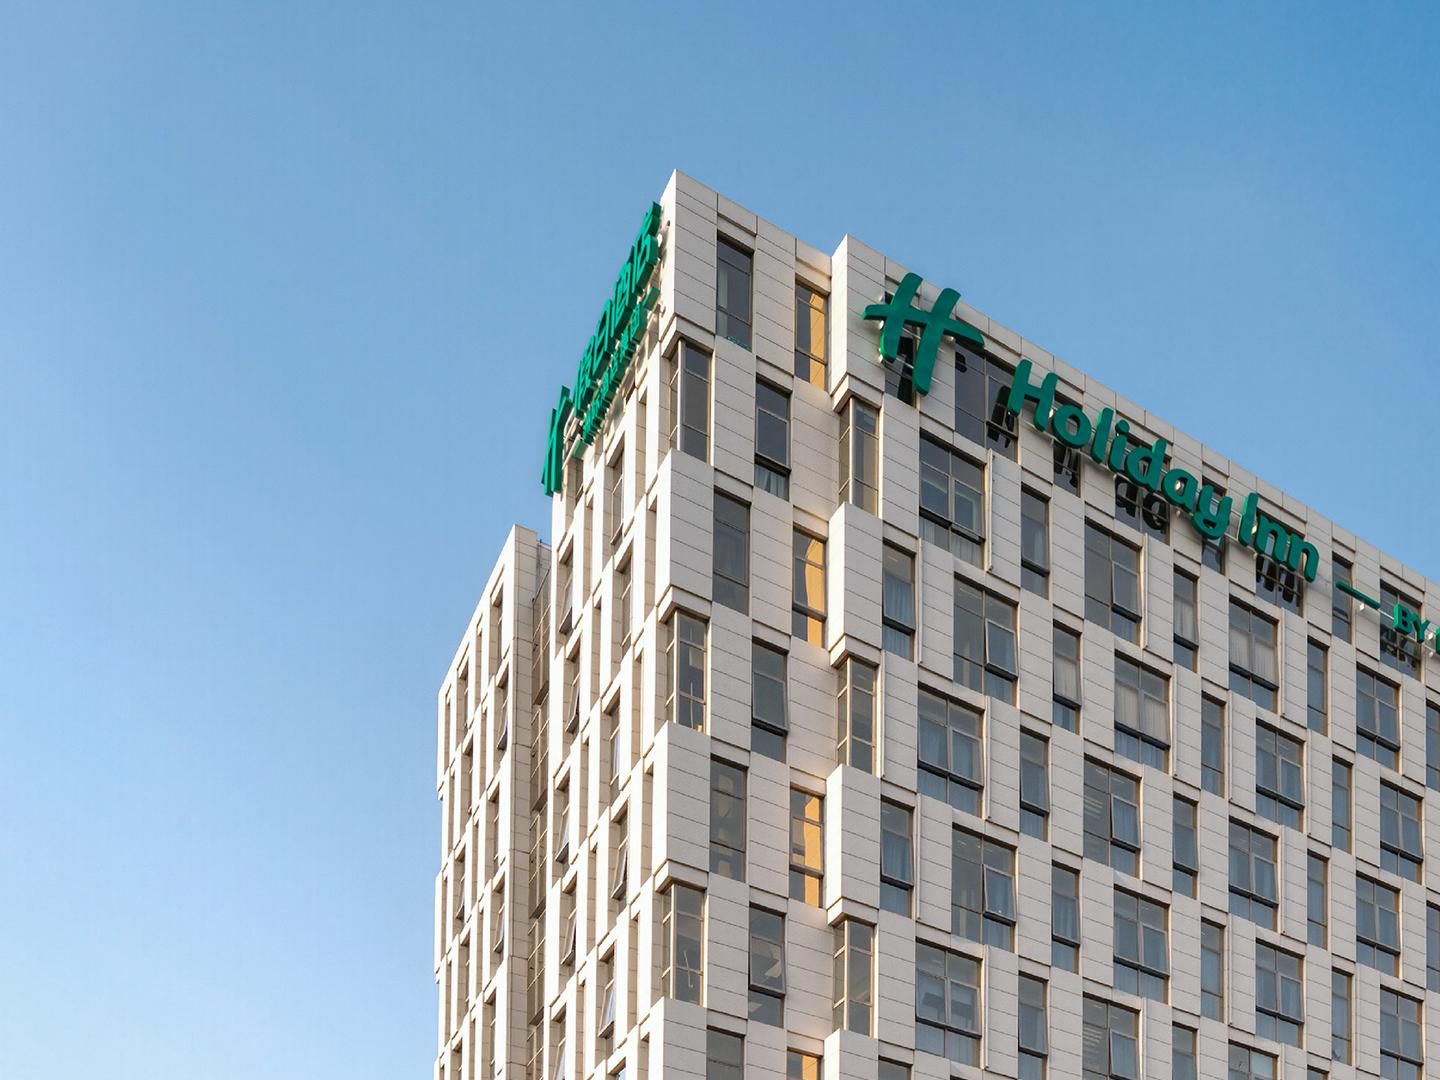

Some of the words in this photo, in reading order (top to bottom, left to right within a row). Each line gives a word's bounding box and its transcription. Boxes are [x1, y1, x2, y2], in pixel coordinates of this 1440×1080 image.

[1007, 358, 1233, 540] Holiday
[1238, 491, 1320, 583] Inn
[1393, 602, 1431, 644] BY
